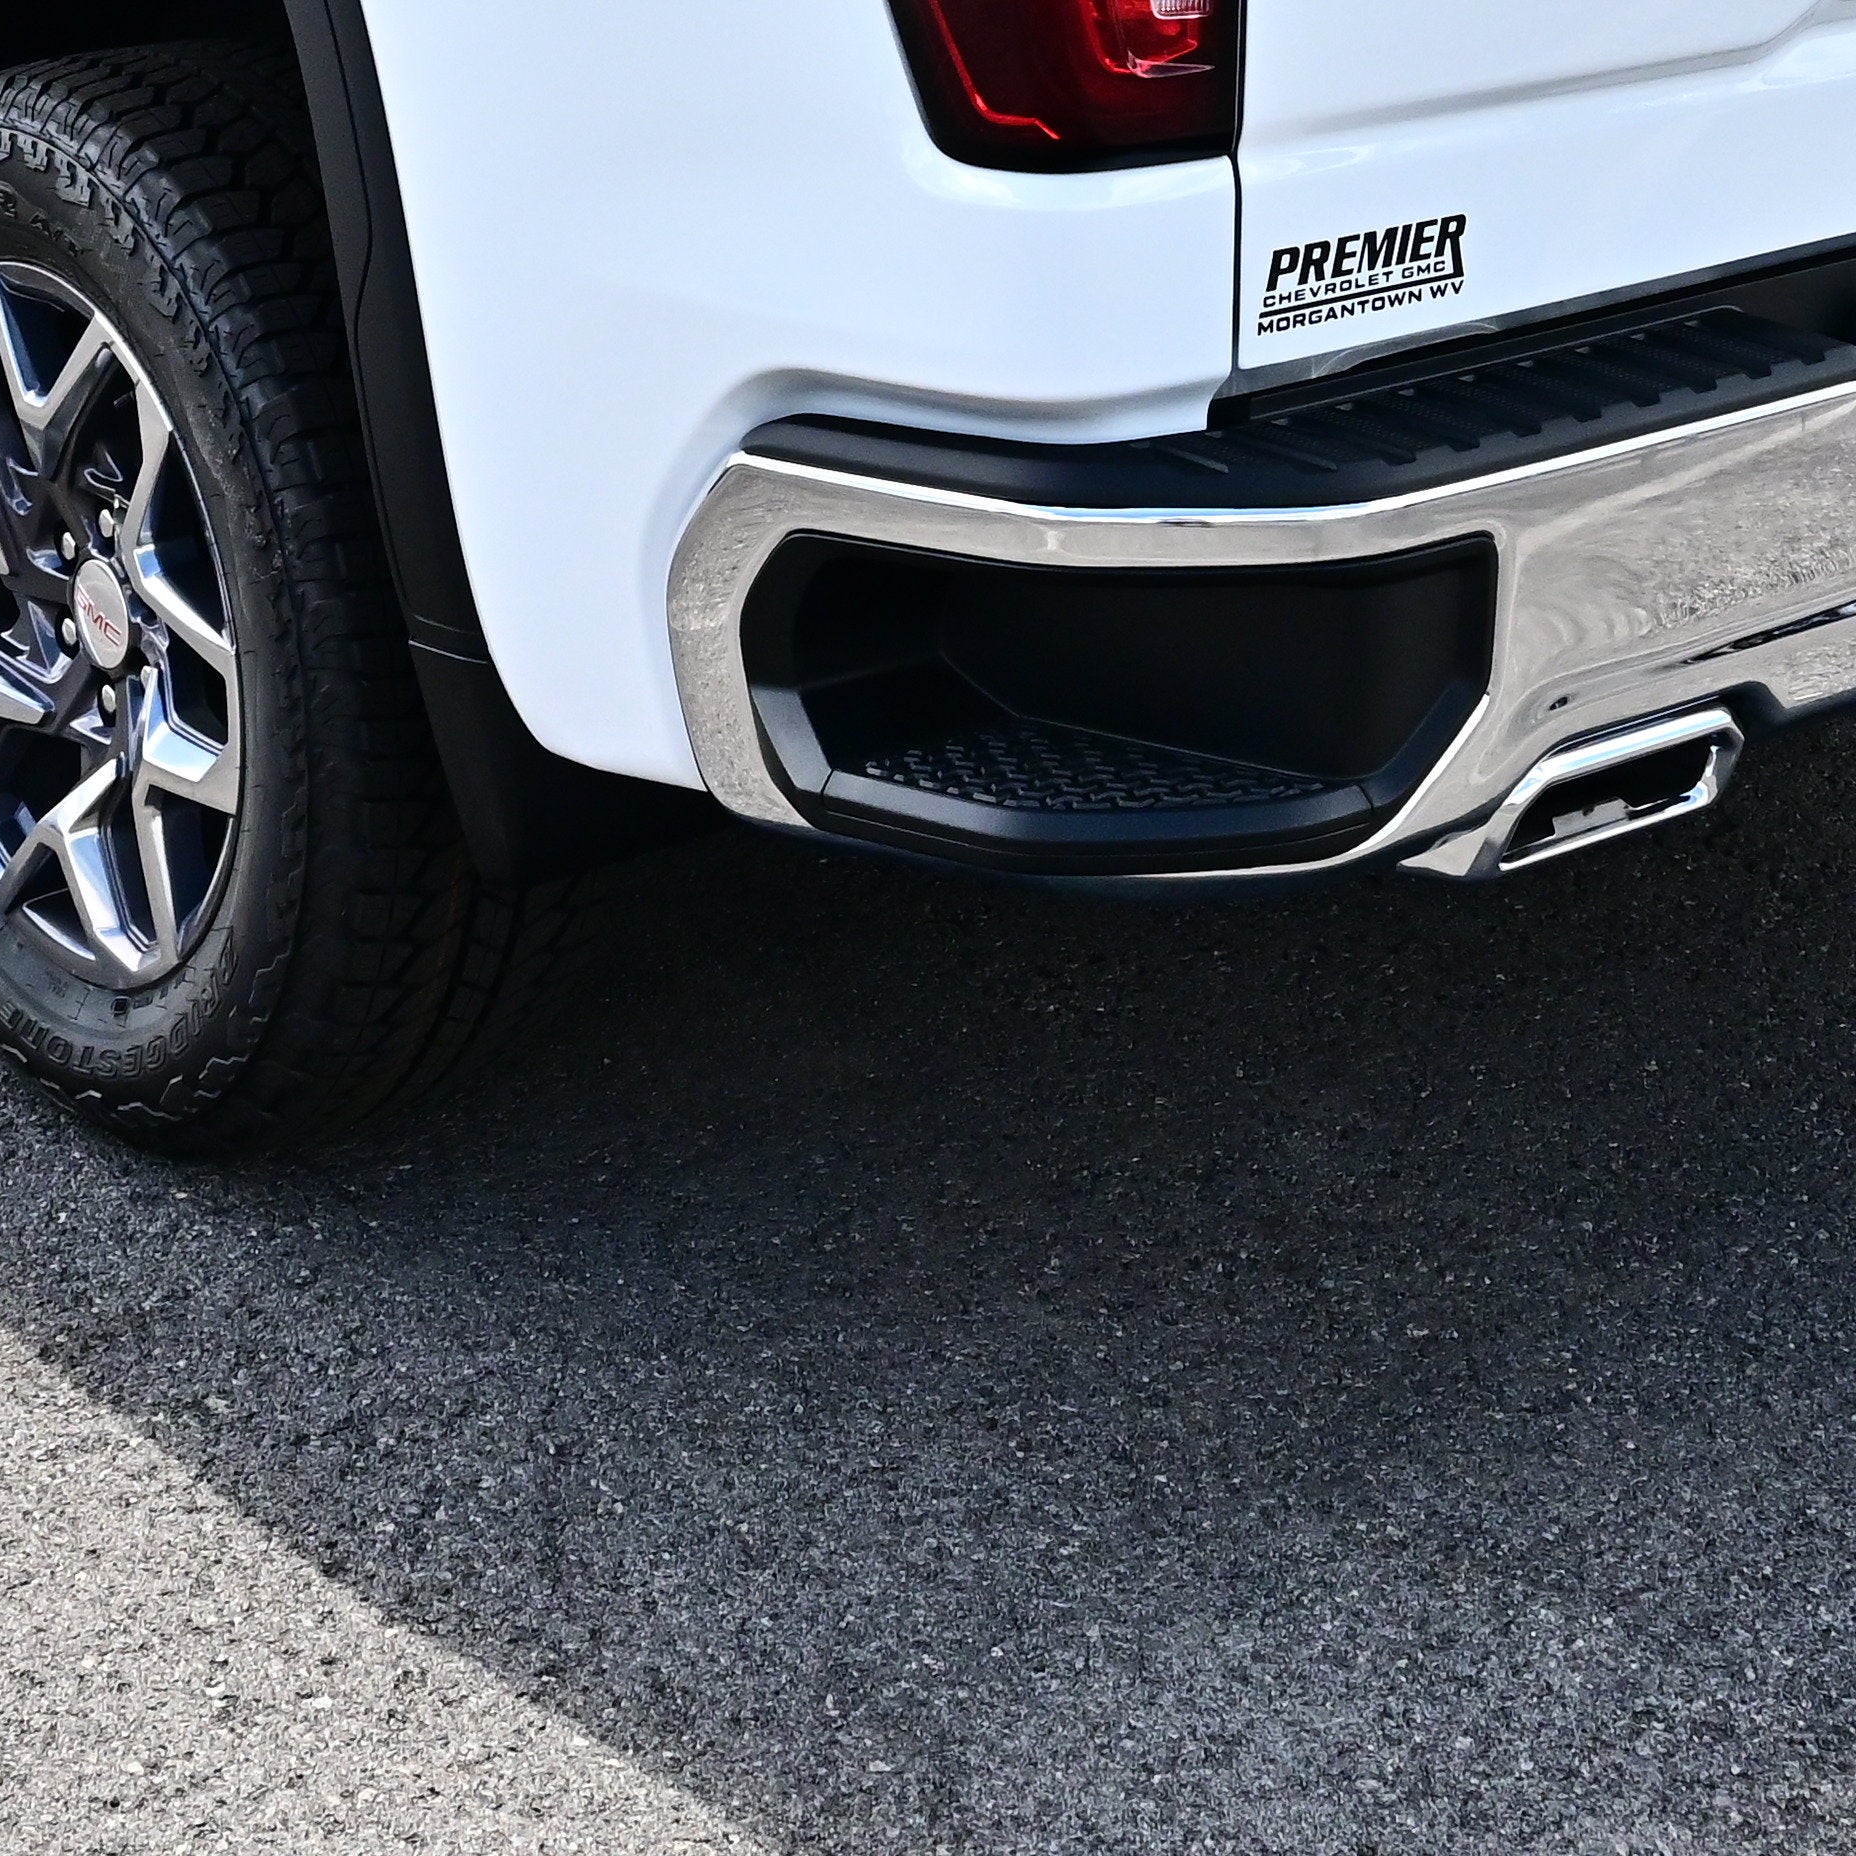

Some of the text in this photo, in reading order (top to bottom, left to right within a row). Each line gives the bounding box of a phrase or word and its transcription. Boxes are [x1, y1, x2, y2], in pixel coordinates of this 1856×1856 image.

[1266, 213, 1467, 292] PREMIER
[1257, 279, 1465, 337] MORGANTOWN WV
[1262, 260, 1446, 308] CHEVROLET GMC
[76, 584, 122, 647] GMC
